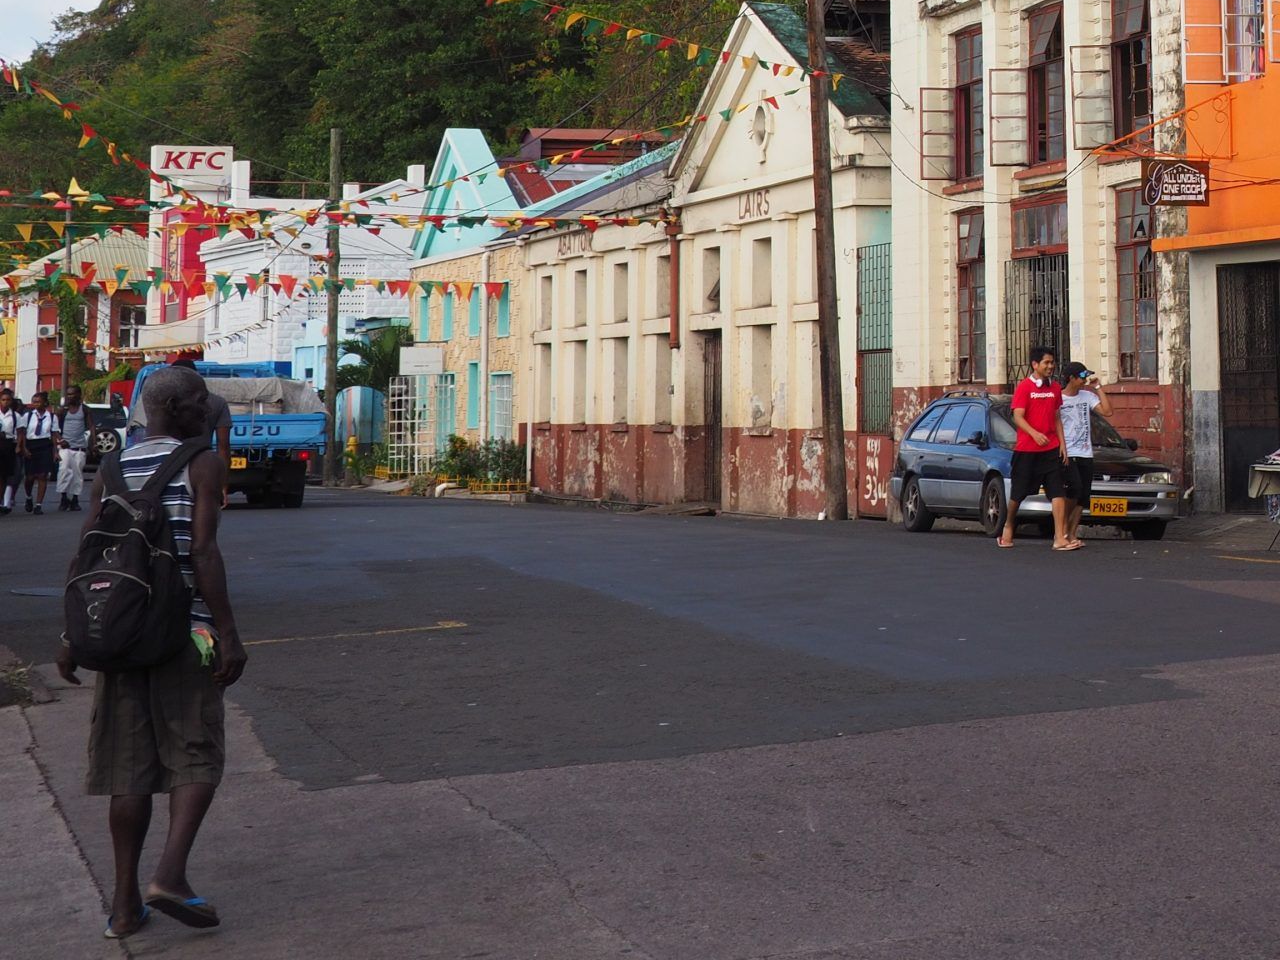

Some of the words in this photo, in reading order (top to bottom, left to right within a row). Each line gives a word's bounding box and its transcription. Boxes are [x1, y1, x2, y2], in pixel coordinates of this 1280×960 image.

[160, 151, 226, 171] KFC
[1163, 173, 1177, 183] ALL
[1163, 184, 1179, 194] ONE
[1180, 184, 1201, 194] ROOF
[233, 426, 280, 437] UZU
[1092, 502, 1124, 513] PN926
